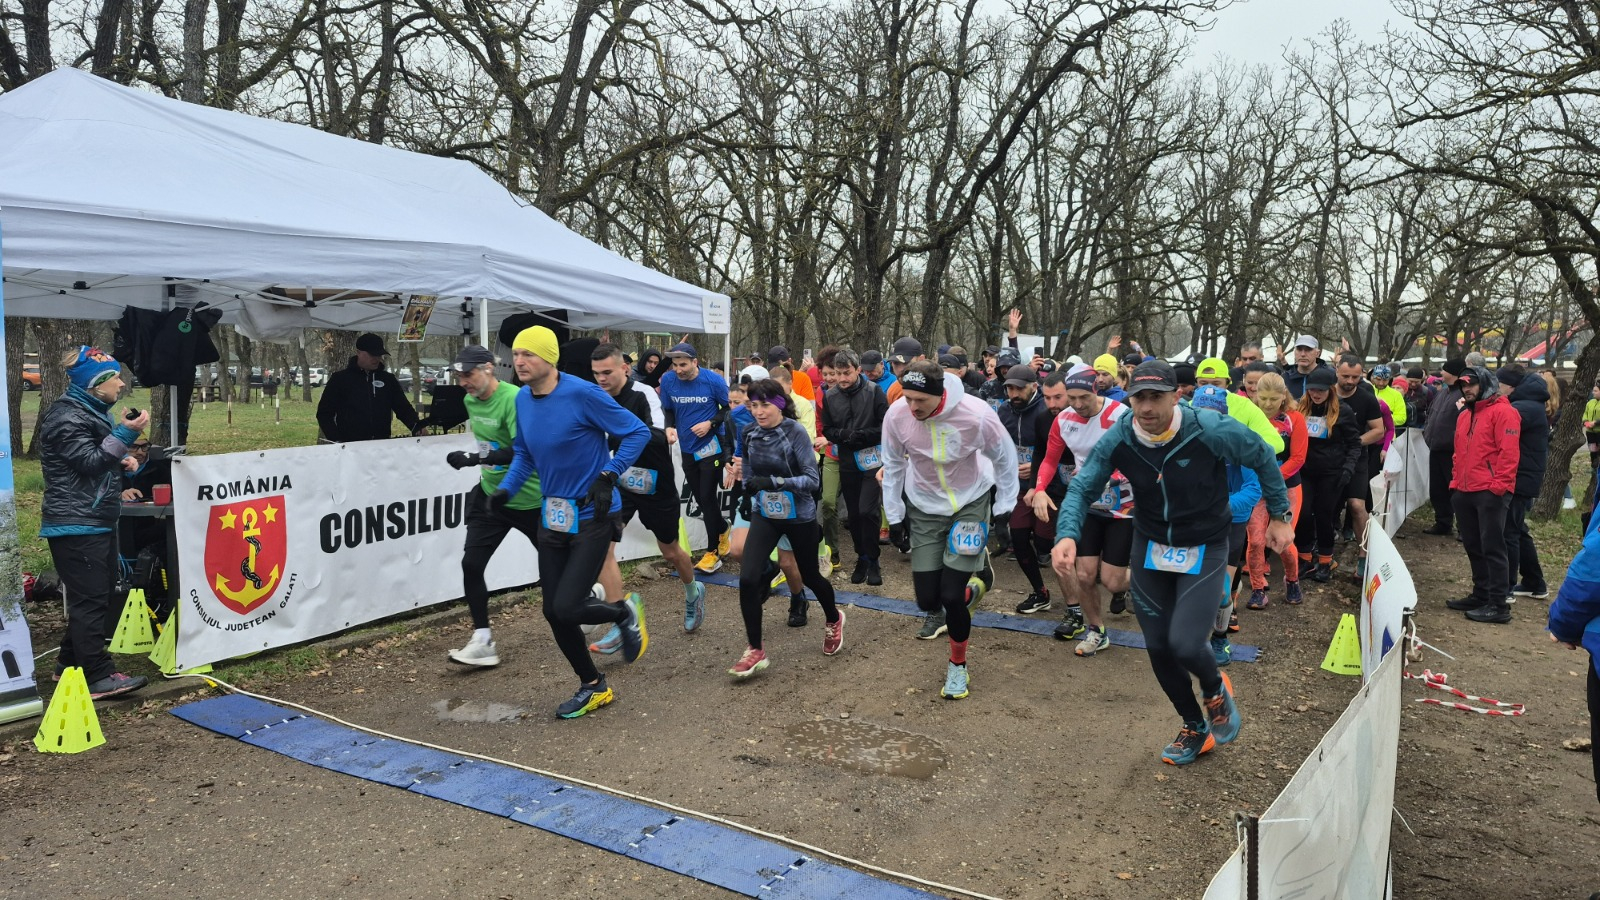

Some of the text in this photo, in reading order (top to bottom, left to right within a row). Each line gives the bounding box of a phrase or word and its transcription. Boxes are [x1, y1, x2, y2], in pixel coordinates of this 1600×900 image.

[864, 454, 878, 464] 64
[197, 474, 292, 501] ROMÂNIA
[628, 476, 644, 488] 94
[767, 501, 783, 513] 39
[551, 508, 565, 524] 36
[956, 533, 981, 547] 146
[1162, 548, 1187, 563] 45
[190, 572, 298, 631] CONSILIUL JUDETEAN GALATI
